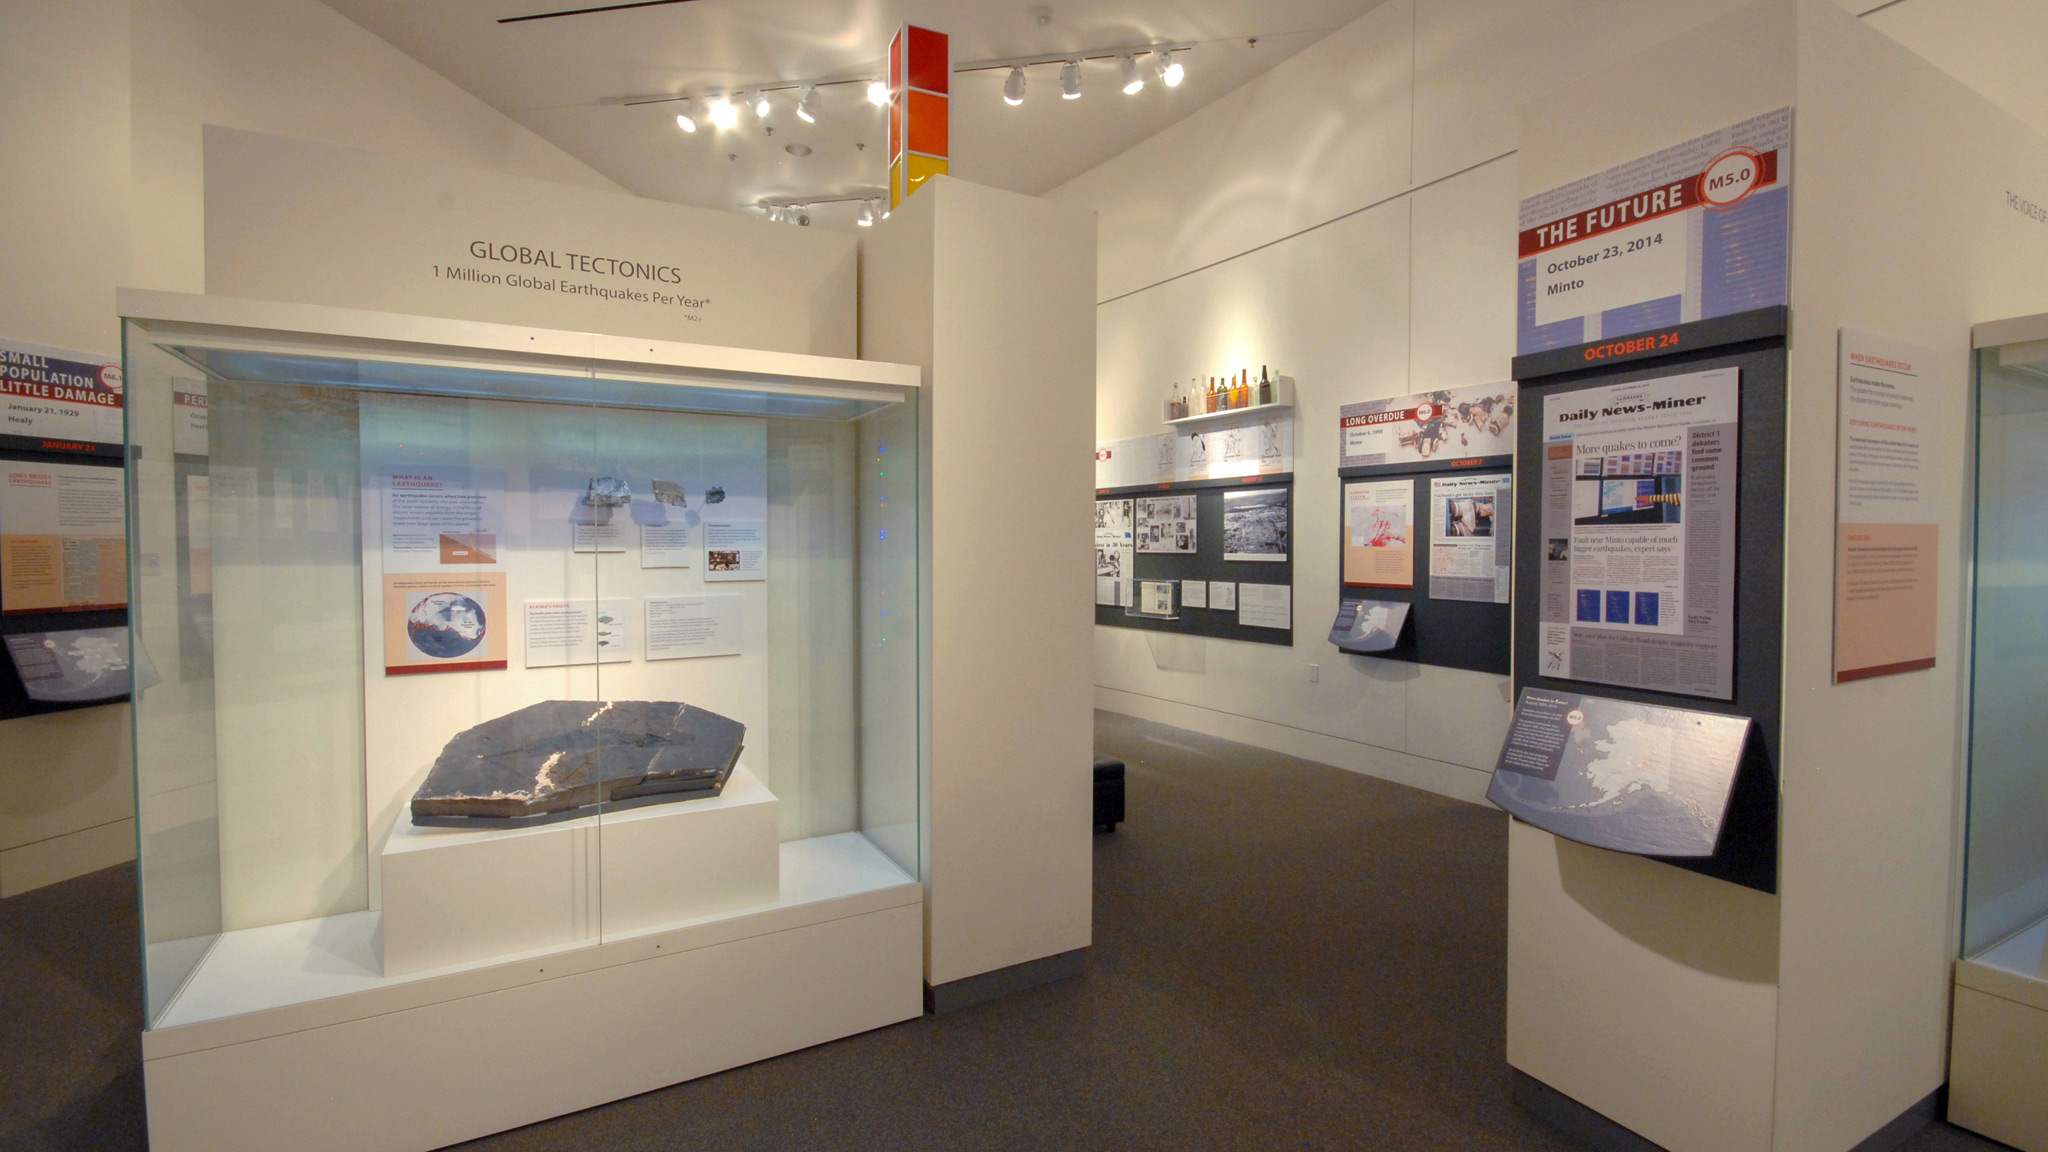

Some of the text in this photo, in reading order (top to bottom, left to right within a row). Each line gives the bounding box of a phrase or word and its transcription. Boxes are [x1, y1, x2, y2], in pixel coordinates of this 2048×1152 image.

[1708, 168, 1750, 191] M5.0
[2006, 191, 2018, 211] THE
[2020, 198, 2038, 221] VOICE
[1537, 184, 1683, 248] THE FUTURE
[469, 240, 682, 284] GLOBAL TECTONICS
[1547, 233, 1663, 274] October 23, 2014
[432, 265, 439, 278] 1
[446, 266, 501, 285] Million
[506, 274, 556, 292] Global
[560, 281, 649, 302] Earthquakes
[653, 291, 674, 306] Per
[1547, 278, 1584, 296] Minto
[1584, 332, 1680, 361] OCTOBER 24
[0, 351, 49, 369] SMALL
[1851, 353, 1865, 362] WHEN
[1865, 355, 1898, 368] EARTHQUAKES
[0, 365, 94, 389] POPULATION
[0, 379, 115, 406] LITTLE DAMAGE
[8, 403, 42, 414] January
[59, 408, 79, 417] 1929
[1559, 395, 1707, 423] Daily News-Miner
[8, 416, 33, 426] Healy
[1346, 411, 1405, 427] LONG OVERDUE
[1692, 430, 1715, 439] District
[42, 441, 84, 451] JANUARY
[1576, 435, 1682, 455] More quakes to come?
[1691, 455, 1719, 463] common
[1691, 464, 1715, 472] ground
[1573, 545, 1671, 554] bigger earthquakes, expert says
[1574, 536, 1588, 544] Fault
[1606, 536, 1624, 544] Minto
[1625, 536, 1650, 545] capable
